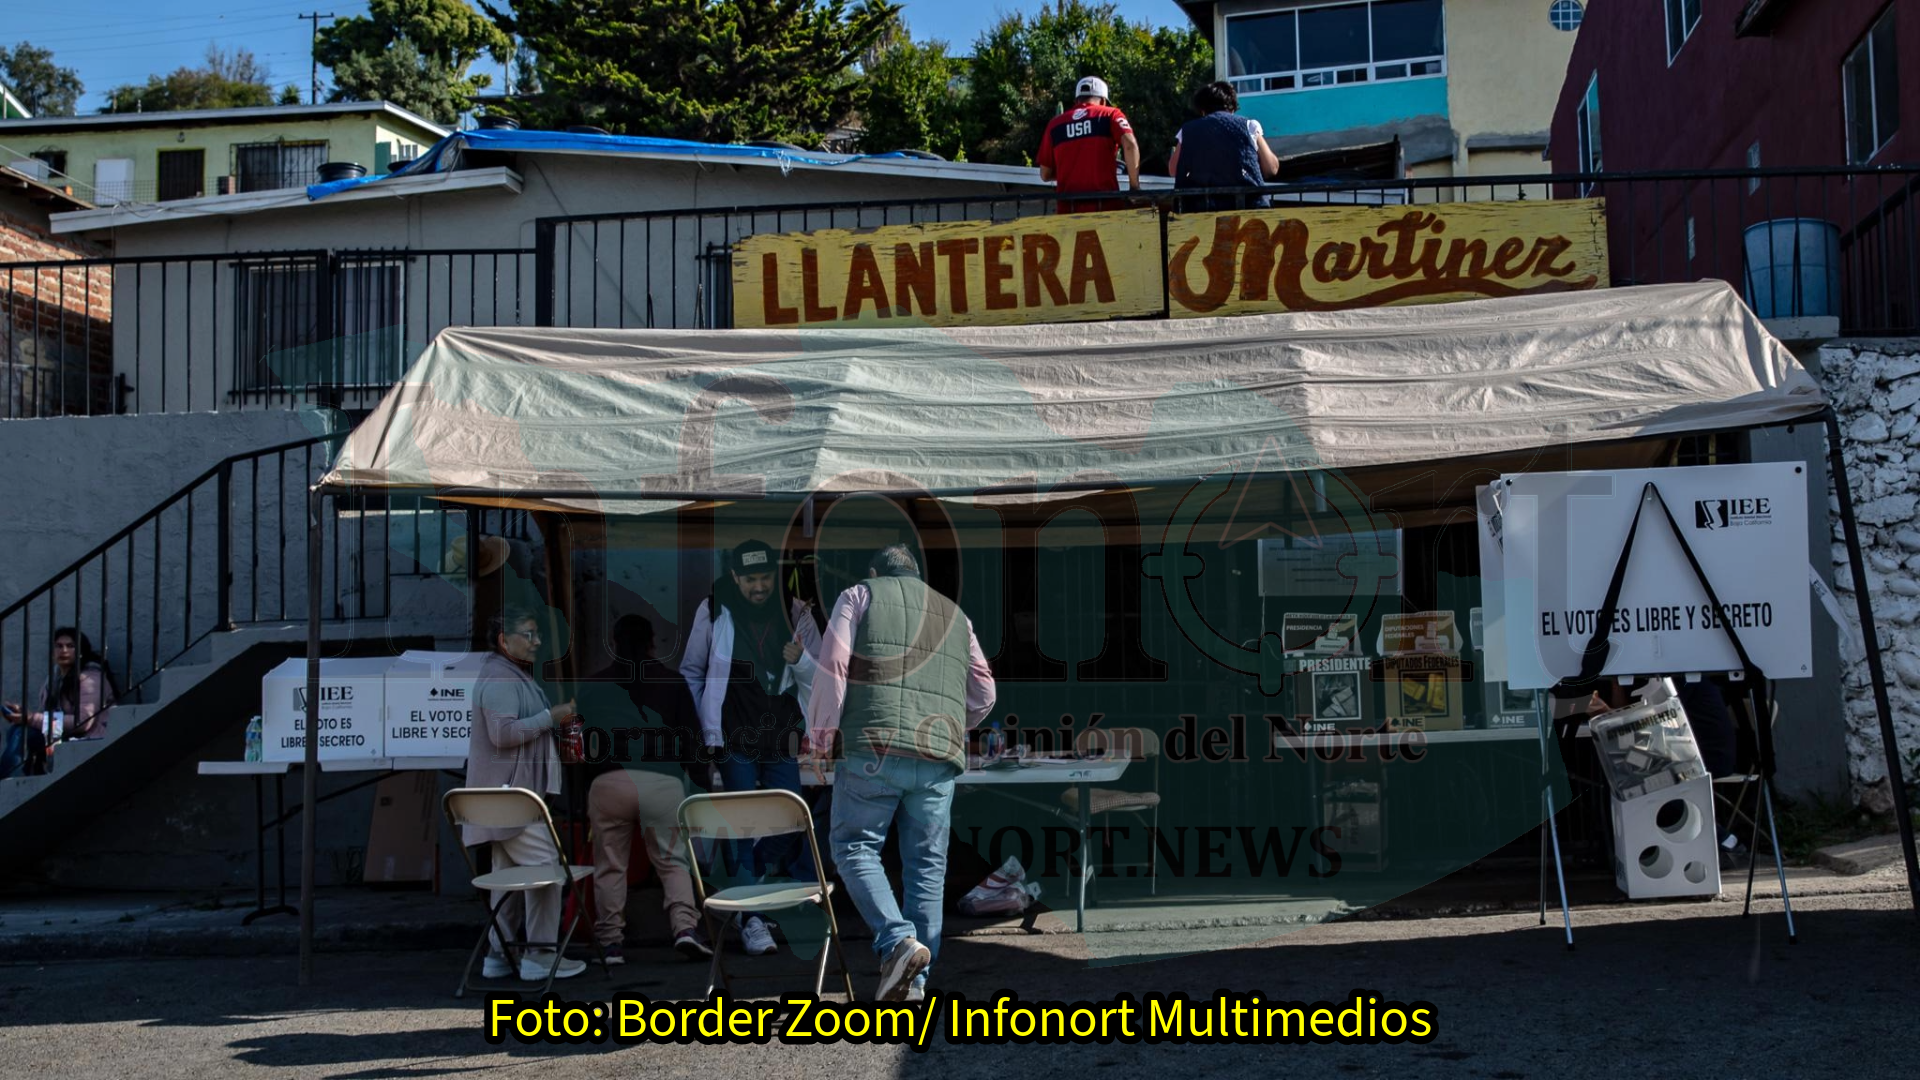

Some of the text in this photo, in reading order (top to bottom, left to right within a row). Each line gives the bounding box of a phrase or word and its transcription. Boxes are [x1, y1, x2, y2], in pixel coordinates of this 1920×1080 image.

[1066, 120, 1092, 138] USA
[762, 229, 1116, 326] LLANTERA
[1731, 498, 1771, 515] IEE
[1542, 611, 1560, 635] EL
[1612, 608, 1630, 633] ES
[1636, 606, 1681, 632] LIBRE
[1685, 605, 1696, 630] Y
[1701, 602, 1772, 629] SECRETO
[1384, 624, 1425, 632] DIPUTACIONES
[1299, 657, 1372, 672] PRESIDENTE
[321, 686, 353, 701] IEE
[441, 688, 465, 697] INE
[410, 710, 473, 722] EL VOTO E
[1402, 717, 1422, 727] INE
[1502, 715, 1525, 724] INE
[294, 718, 352, 730] EL OTO ES
[1312, 722, 1335, 732] INE
[392, 727, 428, 739] LIBRE
[431, 727, 439, 739] Y
[281, 734, 365, 748] LIBRE SECRETO
